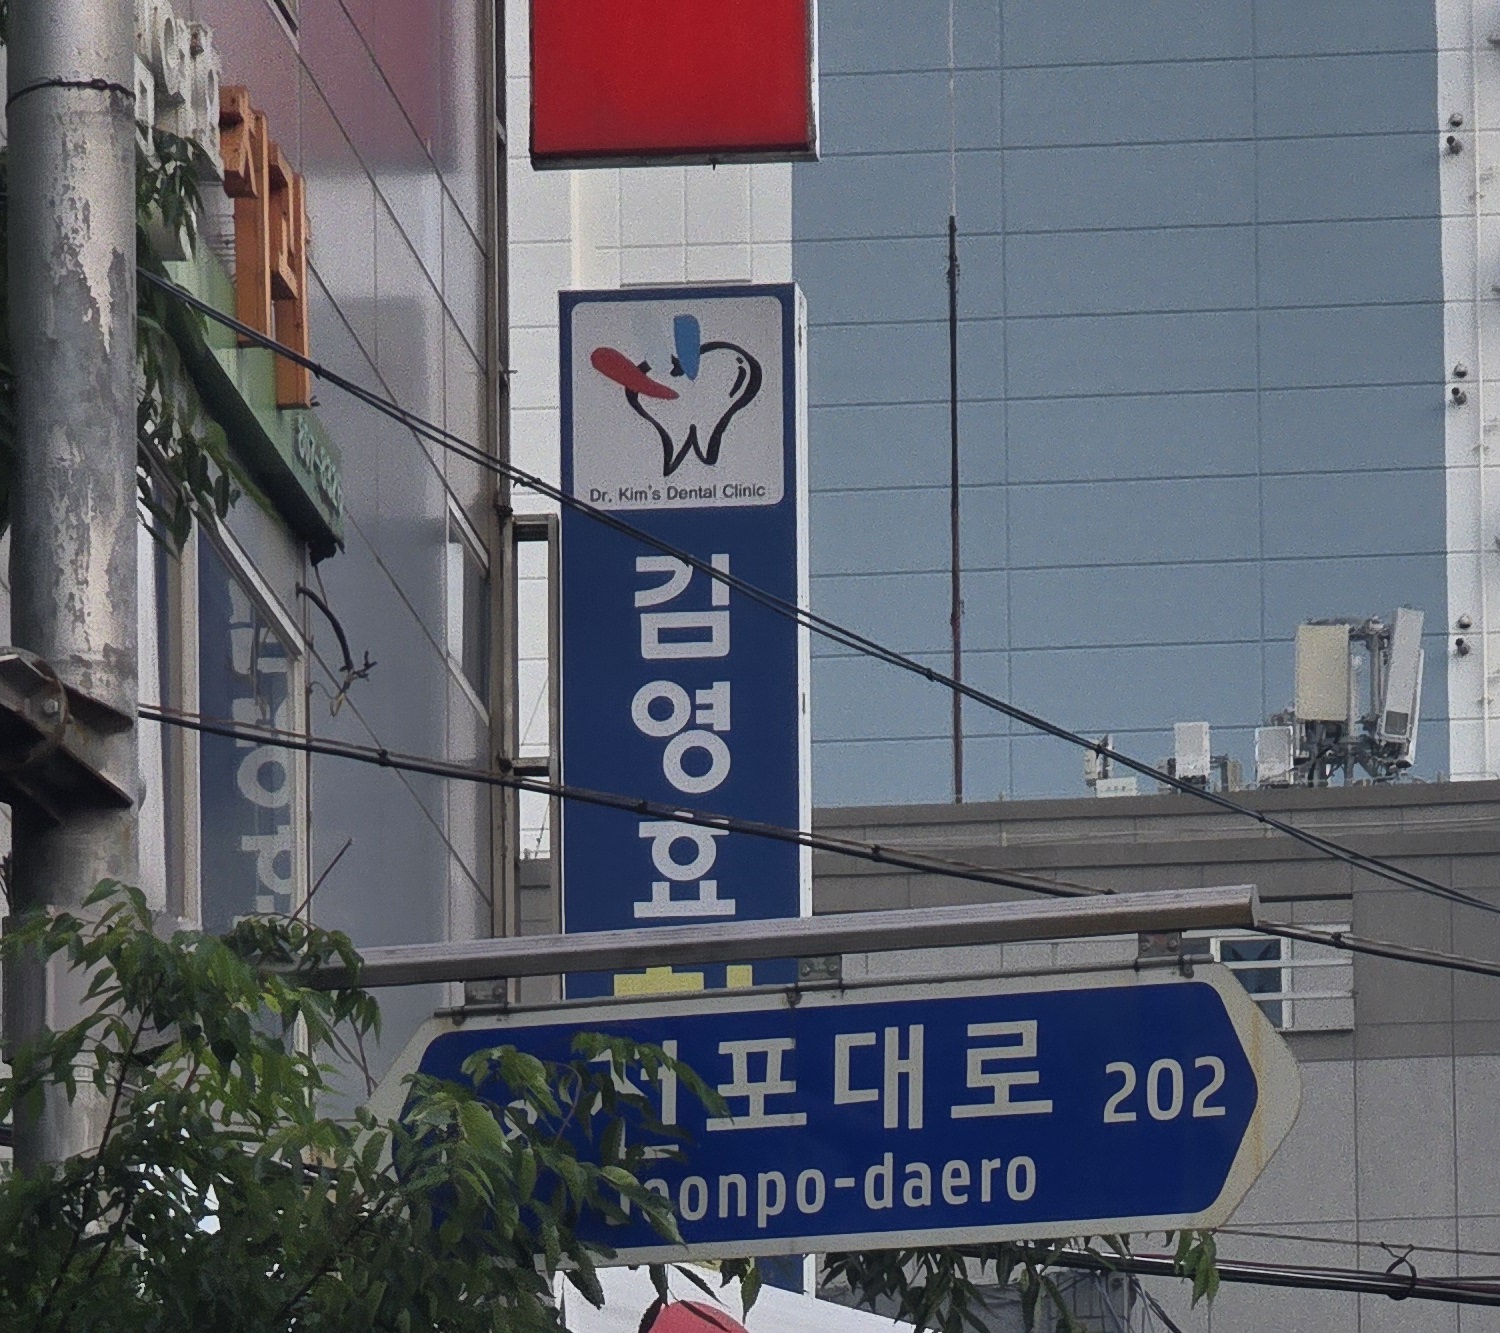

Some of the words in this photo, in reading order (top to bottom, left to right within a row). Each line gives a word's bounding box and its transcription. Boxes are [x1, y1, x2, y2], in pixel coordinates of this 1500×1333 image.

[589, 487, 613, 503] Dr.
[618, 484, 662, 502] Kim's
[666, 484, 717, 501] Dental
[722, 483, 767, 499] Clinic
[1102, 1053, 1229, 1126] 202
